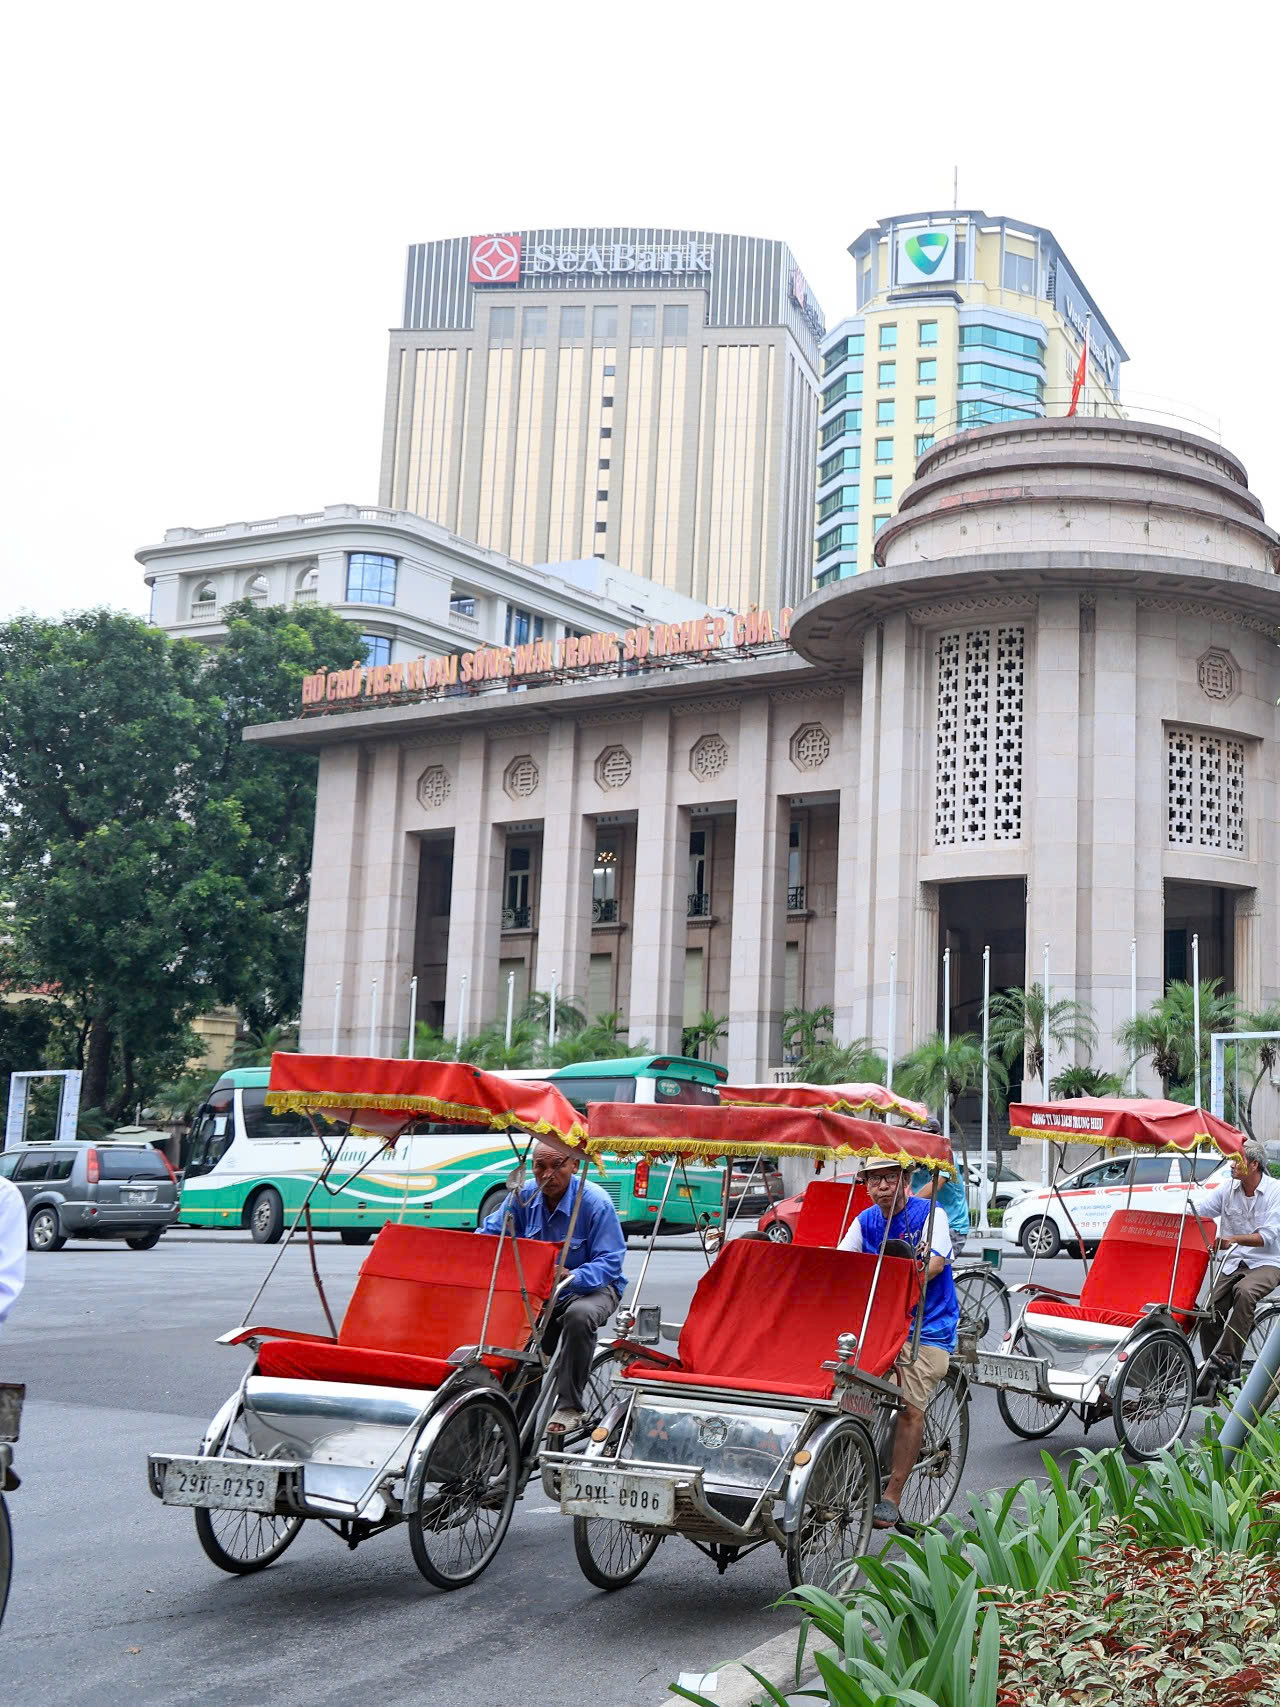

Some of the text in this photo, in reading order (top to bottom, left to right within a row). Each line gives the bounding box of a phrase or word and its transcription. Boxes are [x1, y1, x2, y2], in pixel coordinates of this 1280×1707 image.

[533, 240, 712, 273] SeABank
[460, 641, 512, 683] SỐNG
[514, 636, 554, 675] MÃI
[557, 631, 619, 670] TRONG
[623, 623, 651, 664] SỰ
[653, 612, 726, 658] NGHIỆP
[733, 602, 776, 647] CỦA
[179, 1472, 266, 1500] 29XL-0259
